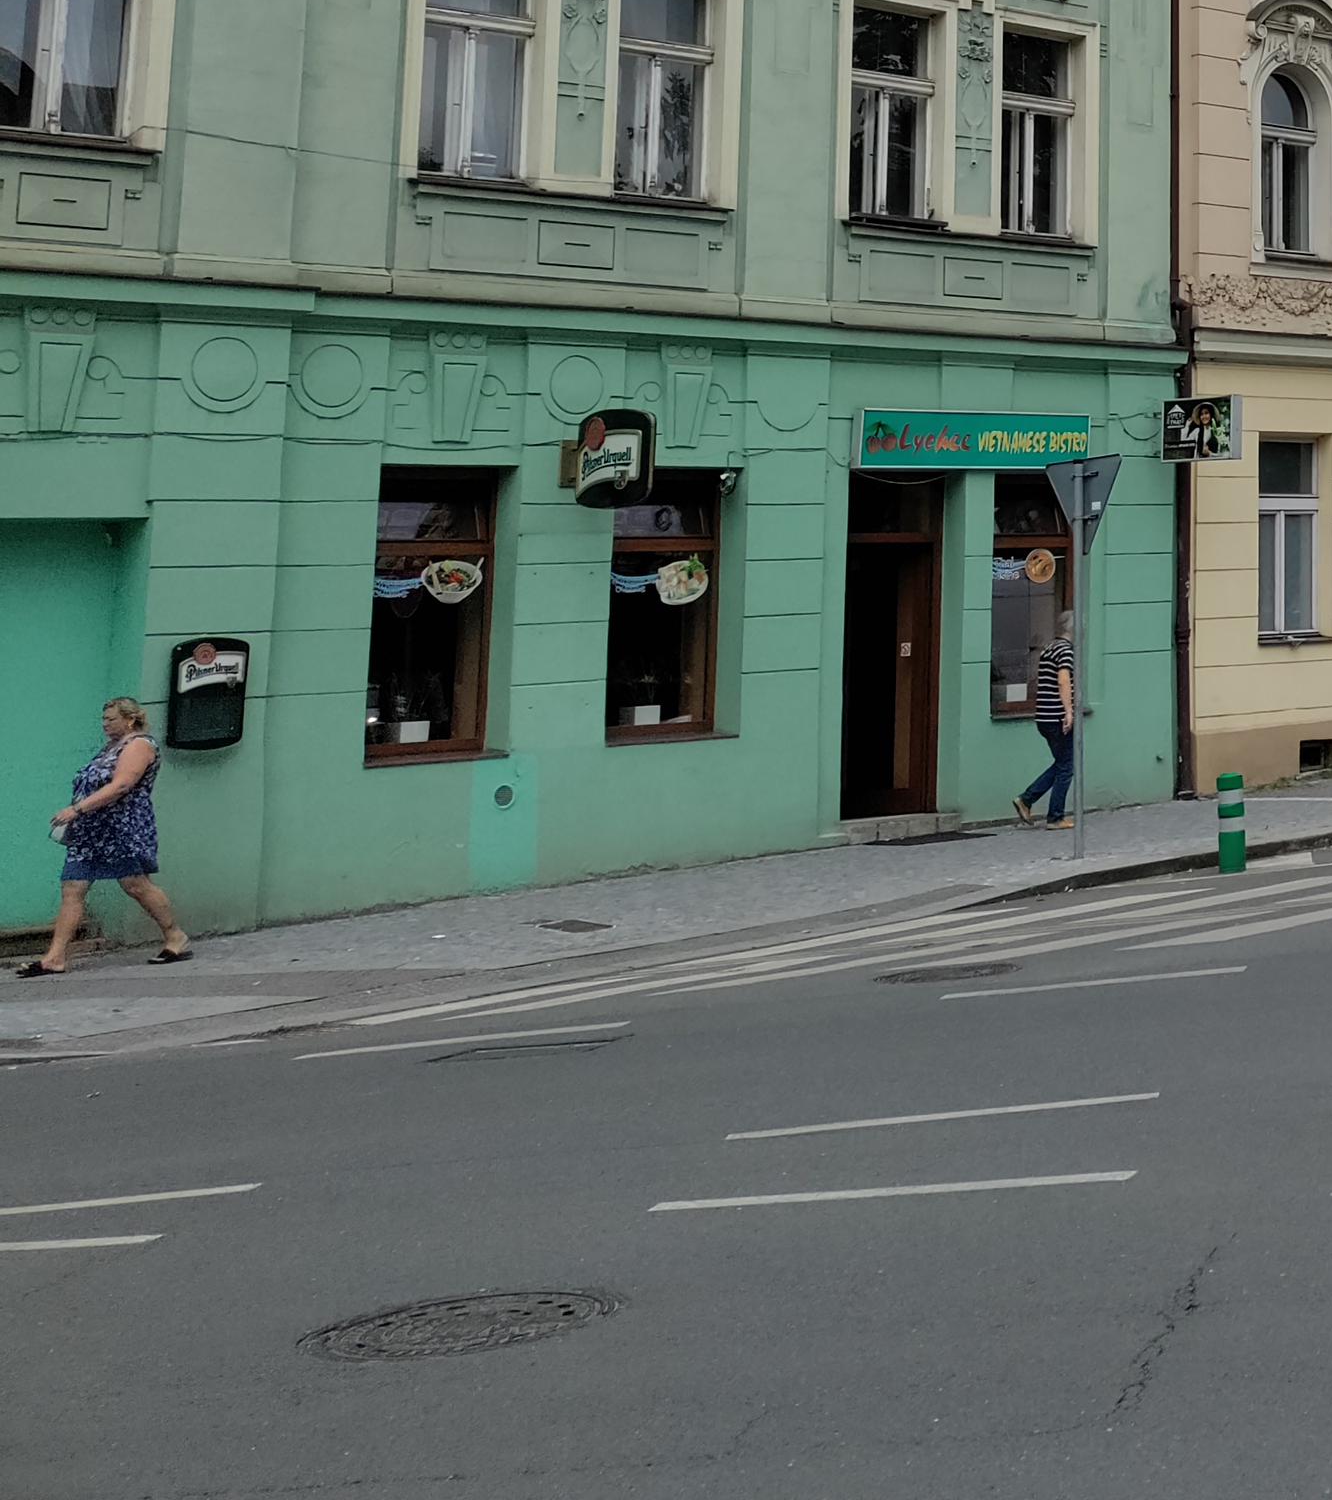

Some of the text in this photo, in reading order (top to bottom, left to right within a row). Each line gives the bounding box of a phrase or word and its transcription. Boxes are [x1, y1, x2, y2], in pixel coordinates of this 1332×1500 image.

[899, 423, 1088, 456] Lychee VIETNAMESE BISTRO
[603, 447, 632, 468] Urquell
